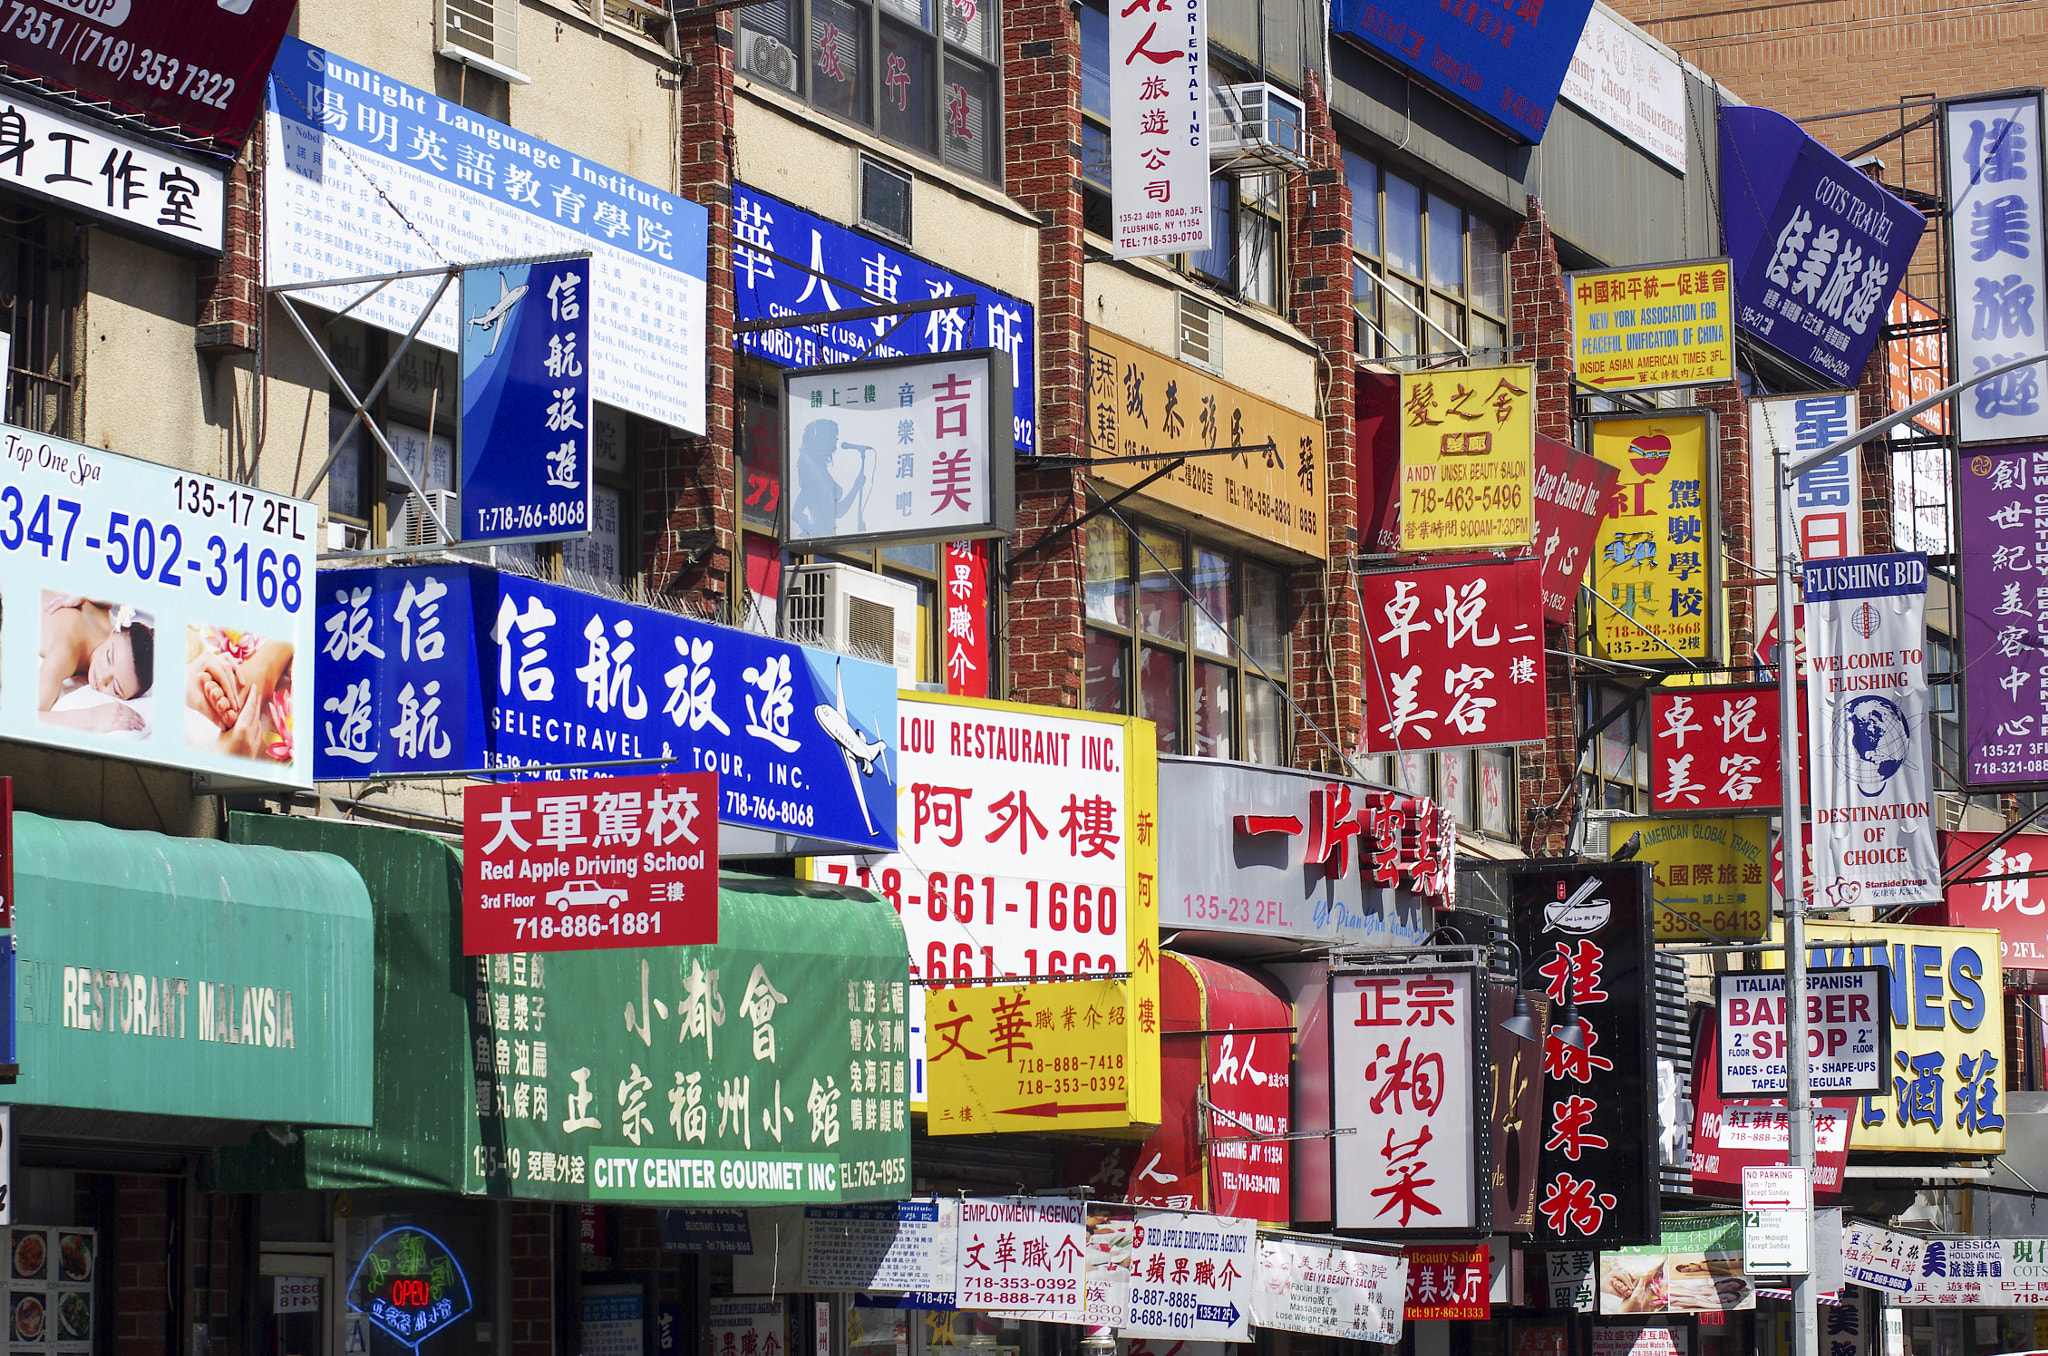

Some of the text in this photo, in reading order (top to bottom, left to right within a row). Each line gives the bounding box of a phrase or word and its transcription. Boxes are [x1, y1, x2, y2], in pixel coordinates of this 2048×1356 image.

[2, 2, 236, 110] 7351 353 7322
[816, 22, 974, 141] 旅行社
[306, 48, 428, 115] Sunlight
[437, 100, 562, 170] Language
[570, 156, 674, 216] Institute
[1139, 75, 1171, 203] 旅遊公司
[1190, 111, 1200, 147] INC
[0, 105, 203, 232] 身工作室
[306, 80, 675, 261] 陽明英語教育學院
[1145, 206, 1204, 220] 40th 3FL
[1164, 218, 1201, 230] NY 11354
[1814, 175, 1894, 247] COTS TRAVEL
[1142, 230, 1204, 246] 718-539-0700
[1765, 204, 1890, 335] 佳美旅遊
[1962, 117, 2040, 419] 佳美旅遊
[1577, 269, 1727, 306] 中國和平統一促進會
[1589, 301, 1717, 330] NEW YORK ASSOCIATION FOR
[1582, 325, 1724, 355] PEACEFUL UNIFICATION OF CHINA
[1580, 349, 1727, 374] INSIDE ASIAN AMERICAN TIMES 3FL.
[543, 271, 584, 490] 信航旅遊
[810, 384, 876, 408] 請上二樓
[1404, 378, 1529, 428] 髮之舍
[895, 381, 916, 517] 音樂酒吧
[930, 373, 972, 516] 吉美
[5, 434, 102, 486] Top One Spa
[1406, 466, 1437, 483] ANDY
[173, 475, 306, 540] 135-17 2FL
[1411, 484, 1522, 515] 718-463-5496
[1460, 517, 1529, 537] 9:00AM-7:30PM
[0, 485, 303, 614] 347-502-3168
[1668, 479, 1704, 618] 駕駛學校
[1806, 560, 1925, 593] FLUSHING BID
[1986, 457, 2034, 737] 創世紀美容中心
[1605, 622, 1701, 638] 718-888-3668
[1507, 623, 1538, 685] 二樓
[1813, 649, 1923, 673] WELCOME TO
[490, 592, 803, 754] 信航旅遊
[1829, 672, 1909, 692] FLUSHING
[1378, 664, 1498, 741] 美容
[490, 706, 810, 791] SELECTRAVEL TOUR, INC.
[951, 721, 1120, 773] RESTAURANT INC.
[1981, 744, 2022, 757] 135-27
[1656, 753, 1762, 805] 美容
[481, 787, 700, 856] 大軍駕校
[726, 790, 815, 828] 718-766-8068
[910, 782, 1121, 861] 阿外樓
[1817, 802, 1930, 824] DESTINATION
[1863, 827, 1886, 843] OF
[480, 850, 705, 883] Red Apple Driving School
[1843, 847, 1908, 866] CHOICE
[649, 881, 686, 902] 三樓
[1865, 878, 1928, 889] Starside Drugs
[480, 892, 536, 909] 3rd Floor
[1184, 893, 1294, 928] 135-23 2FL.
[512, 911, 662, 939] 718-886-1881
[1136, 810, 1157, 1034] 新阿外樓
[1805, 975, 1863, 990] SPANISH
[64, 965, 296, 1049] RESTORANT MALAYSIA
[624, 957, 789, 1064] 小都會
[1353, 974, 1456, 1027] 正宗
[928, 993, 1033, 1064] 文華
[1034, 1004, 1126, 1033] 職業介紹
[1019, 1054, 1124, 1074] 718-888-7418
[1212, 1023, 1268, 1086] 名人
[1728, 1045, 1874, 1058] FLOOR FLOOR
[1727, 1061, 1876, 1076] FADES SHAPE-UPS
[1809, 1076, 1852, 1088] REGULAR
[1018, 1075, 1126, 1096] 718-353-0392
[1539, 938, 1618, 1237] 桂林米粉
[562, 1063, 842, 1150] 正宗福州小館
[940, 1106, 974, 1122] 三樓
[1364, 1036, 1443, 1228] 湘菜
[527, 1150, 586, 1185] 免費外送
[1263, 1149, 1283, 1165] 11354
[594, 1158, 837, 1192] CITY CENTER GOURMET INC
[1746, 1170, 1793, 1179] NO PARKING
[1747, 1189, 1790, 1198] Except Sunday
[962, 1204, 1084, 1224] EMPLOYMENT AGENCY
[1747, 1212, 1758, 1227] 2
[963, 1231, 1085, 1274] 文華職介
[1147, 1228, 1248, 1254] RED APPLE EMPLOYEE AGENCY
[1748, 1241, 1791, 1250] Except Sunday
[1949, 1241, 2000, 1250] JESSICA
[1949, 1251, 2002, 1260] HOLDING INC.
[1412, 1250, 1483, 1264] Beauty Salon
[1949, 1260, 2002, 1278] 旅遊集團
[963, 1277, 1077, 1290] 718-353-0392
[1290, 1282, 1313, 1293] Facial
[1303, 1271, 1378, 1290] MEI YA BEAUTY SALON
[963, 1291, 1077, 1305] 718-888-7418
[1290, 1303, 1322, 1315] Massage
[1893, 1294, 1981, 1304] 七天營業
[1199, 1308, 1235, 1321] 135-21 2FL
[1406, 1307, 1484, 1319] Tel: 917-862-1333
